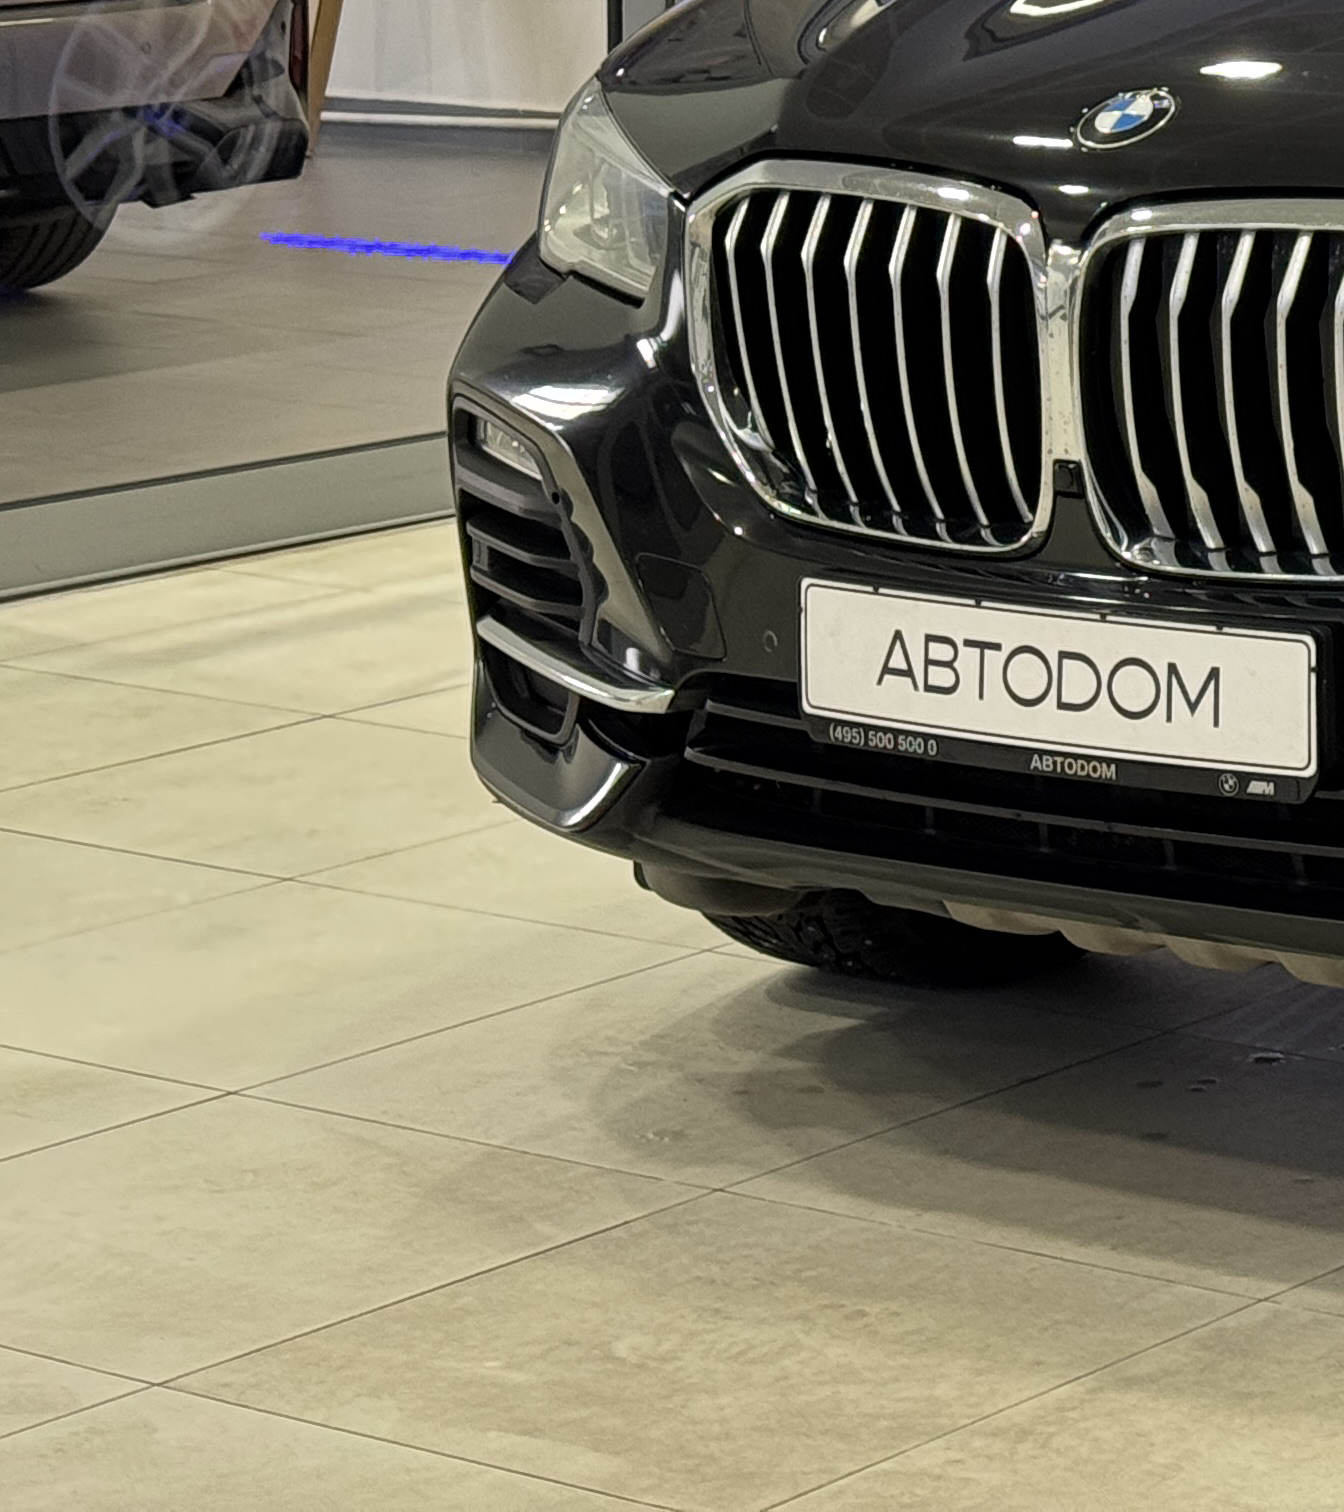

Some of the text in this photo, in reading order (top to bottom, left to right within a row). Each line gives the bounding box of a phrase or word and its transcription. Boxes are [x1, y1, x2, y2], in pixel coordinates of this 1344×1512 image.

[876, 628, 1221, 729] ABTODOM
[829, 722, 938, 756] (495) 500 500 0
[1029, 753, 1117, 781] ABTODOM
